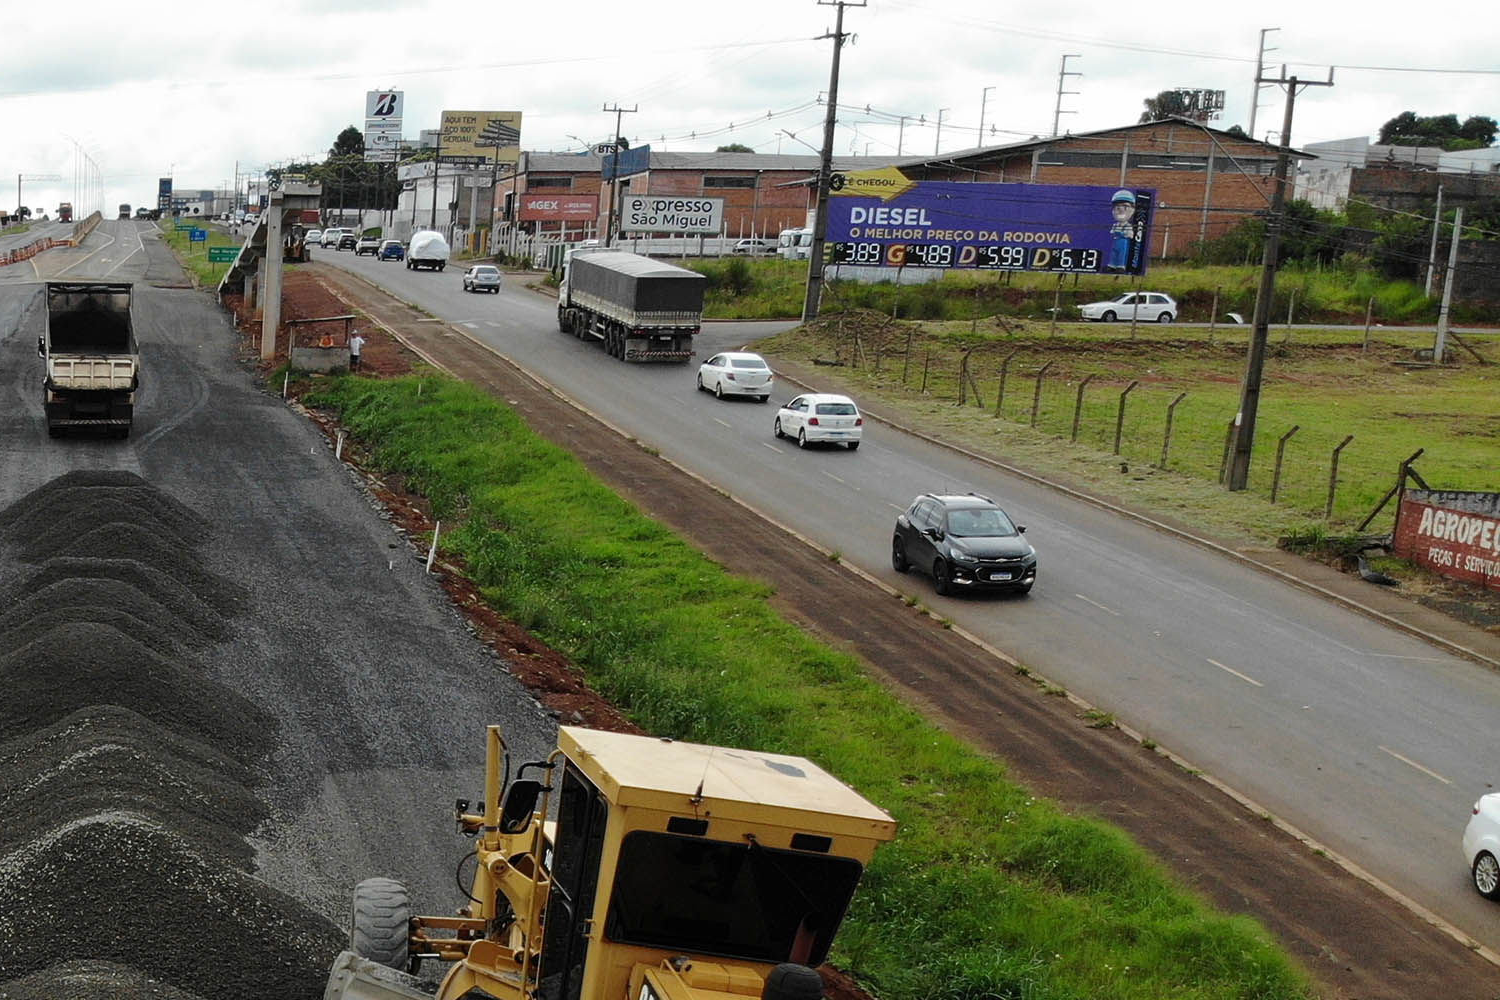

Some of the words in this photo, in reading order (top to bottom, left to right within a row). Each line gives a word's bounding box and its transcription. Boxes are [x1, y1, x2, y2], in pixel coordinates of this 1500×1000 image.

[856, 179, 896, 187] CHEGOU
[631, 212, 658, 226] São
[662, 213, 712, 229] Miguel
[850, 206, 932, 226] DIESEL
[849, 227, 861, 238] O
[864, 228, 923, 240] MELHOR
[926, 229, 974, 243] PREÇO
[978, 230, 999, 242] DA
[1003, 231, 1071, 244] RODOVIA
[845, 242, 881, 262] 3.89
[887, 244, 906, 263] G
[915, 244, 952, 264] 4.89
[958, 246, 976, 264] D
[987, 246, 1024, 266] 5.99
[1032, 248, 1050, 267] D
[1428, 546, 1453, 568] PEÇAS
[1456, 553, 1461, 568] E
